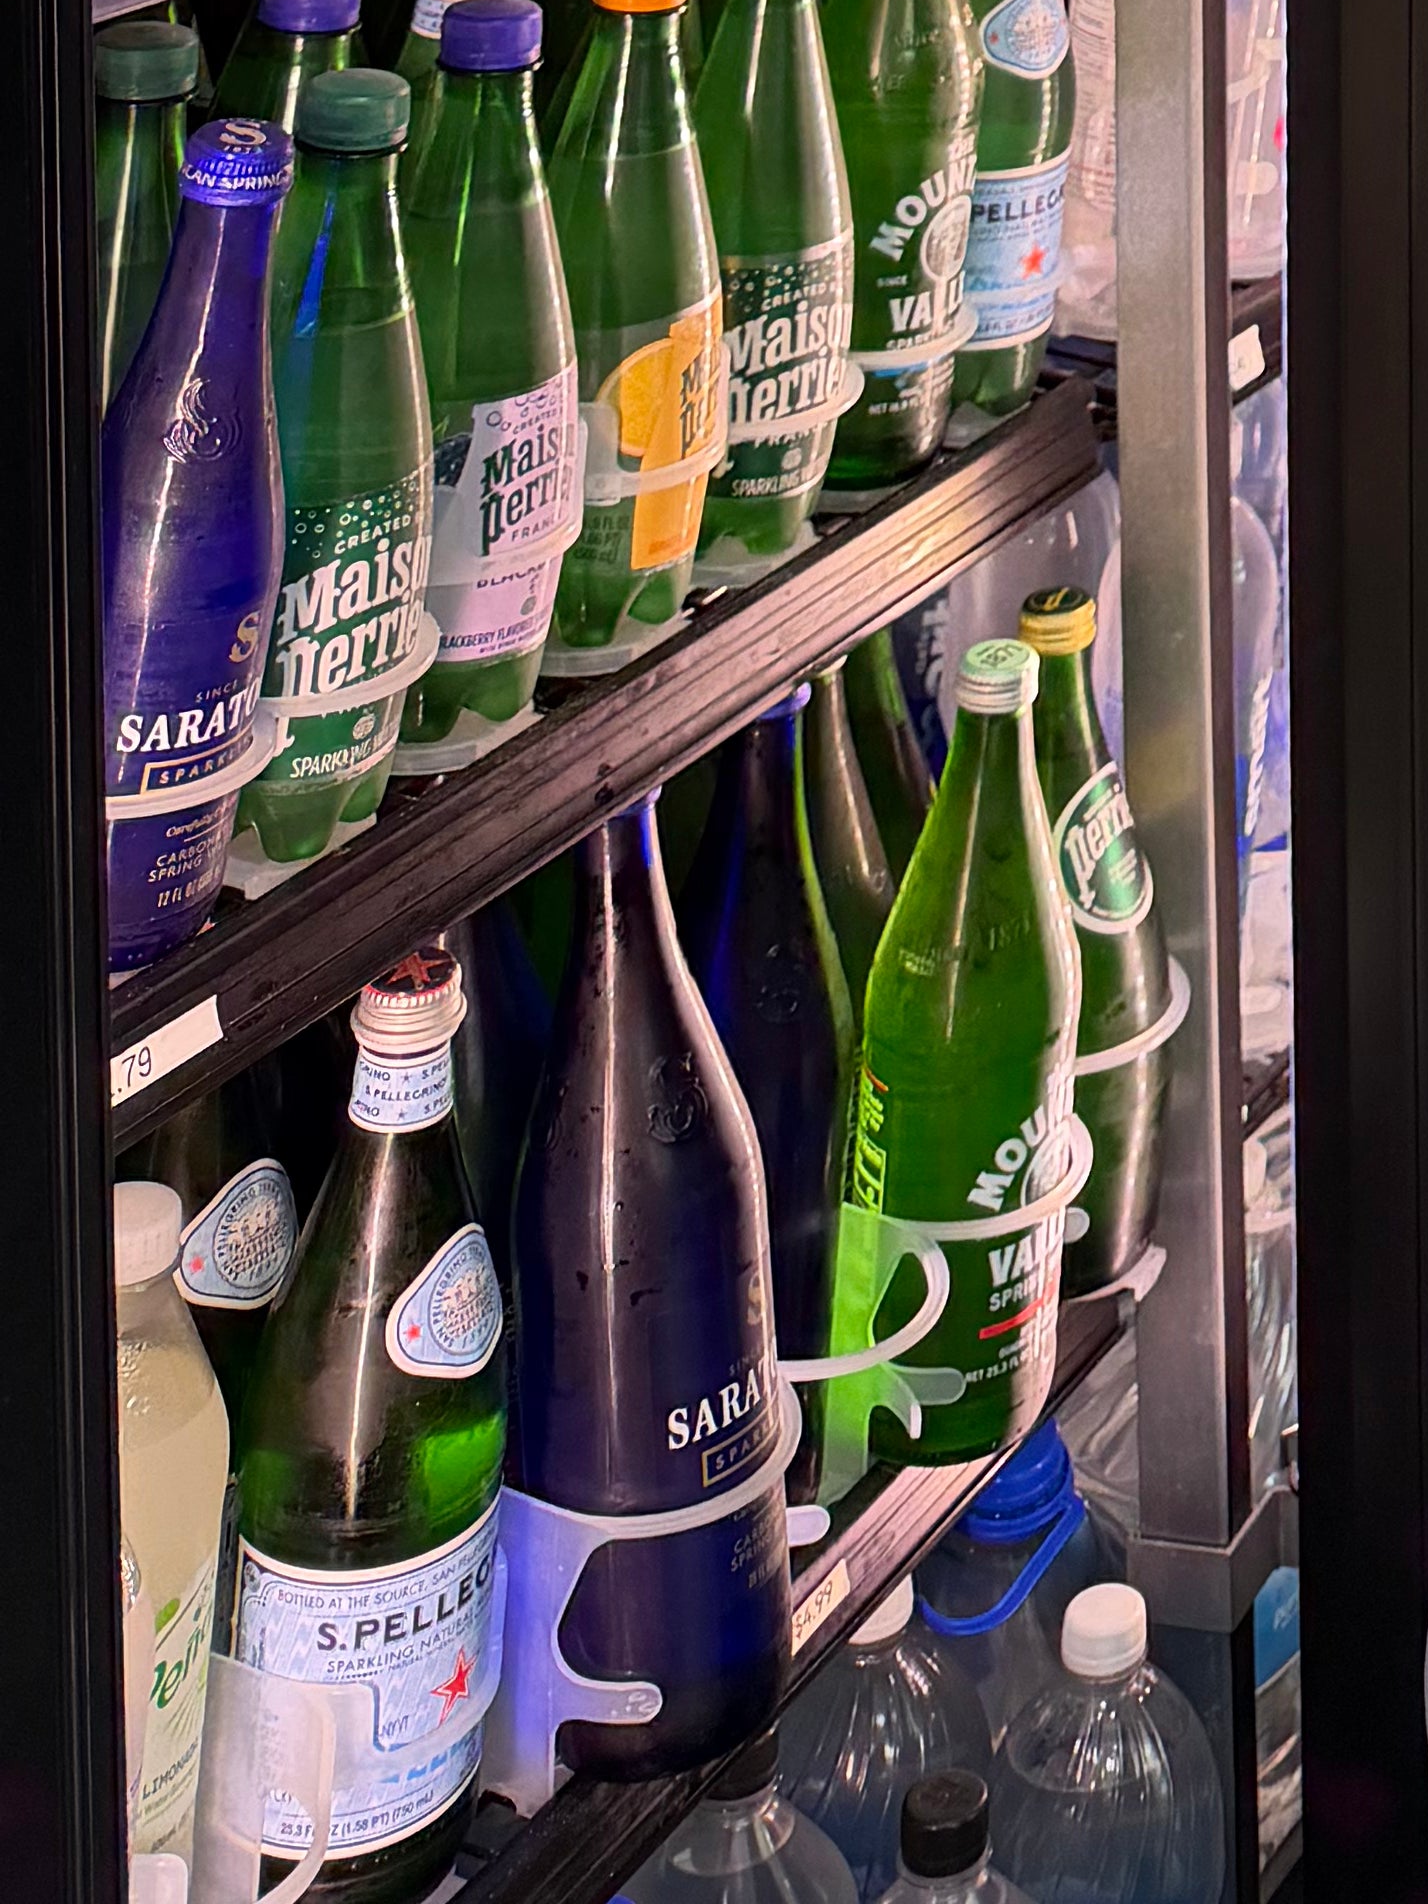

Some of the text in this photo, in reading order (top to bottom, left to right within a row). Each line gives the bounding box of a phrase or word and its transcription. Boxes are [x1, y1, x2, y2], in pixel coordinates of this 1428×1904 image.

[219, 121, 268, 145] S
[762, 282, 828, 312] CREATED
[334, 513, 412, 554] CREATED
[116, 676, 260, 753] SARATO
[277, 1588, 325, 1610] BOTTLED
[327, 1596, 344, 1610] AT
[347, 1593, 370, 1610] THE
[431, 1565, 456, 1591] SAN
[326, 1612, 475, 1677] SPARKLING NATURAL
